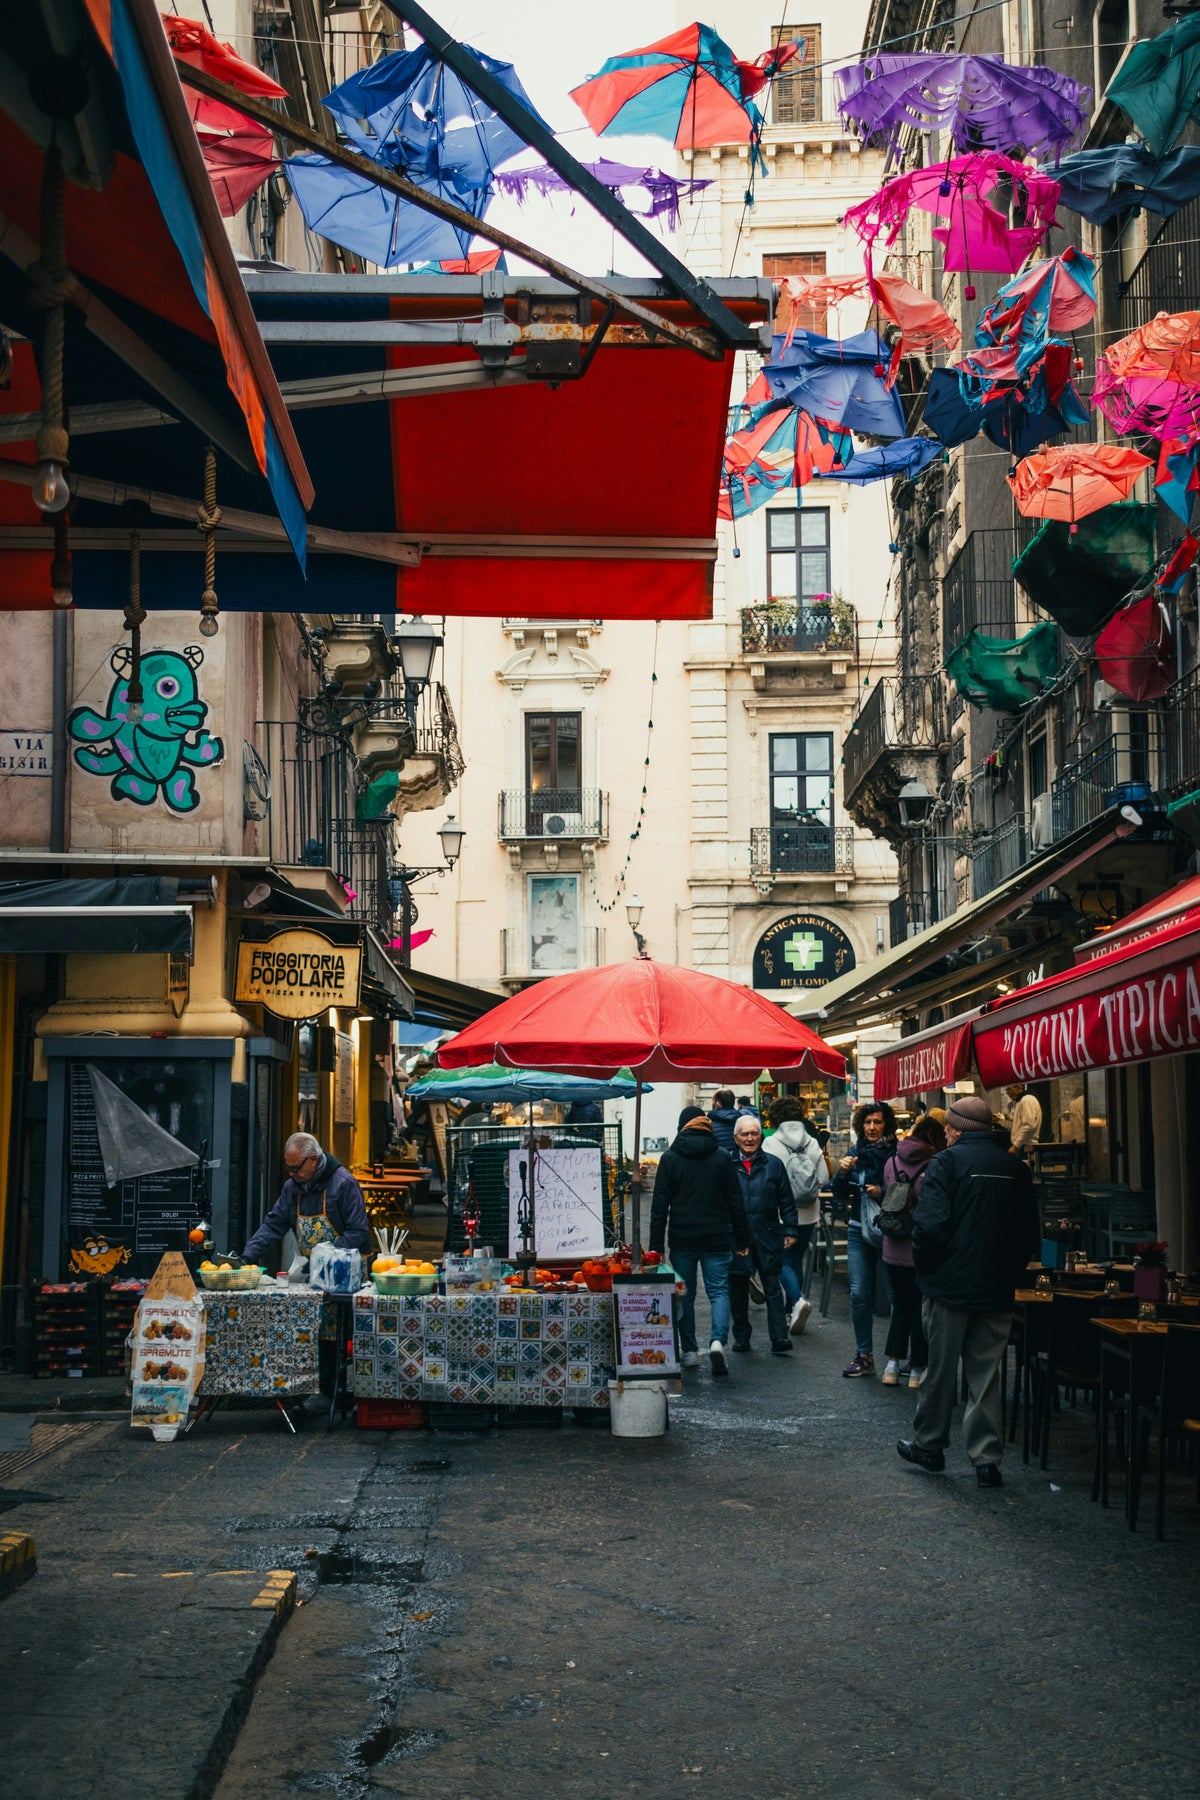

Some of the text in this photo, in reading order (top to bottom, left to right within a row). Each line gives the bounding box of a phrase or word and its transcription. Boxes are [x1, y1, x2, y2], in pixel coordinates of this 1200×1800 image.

[14, 738, 44, 750] VIA
[0, 757, 53, 770] GISIR
[763, 917, 845, 942] ANTICA FARMACIA
[252, 951, 345, 971] FRIGGITORIA
[250, 967, 345, 989] POPOLARE
[780, 977, 830, 987] BELLOMO
[266, 989, 294, 997] PIZZA
[310, 991, 344, 999] FRITTA
[1098, 965, 1200, 1062] TIPICA
[144, 1307, 196, 1318] SPREMUTE
[630, 1331, 663, 1340] SPREMUTA
[139, 1348, 192, 1358] SPREMUTE
